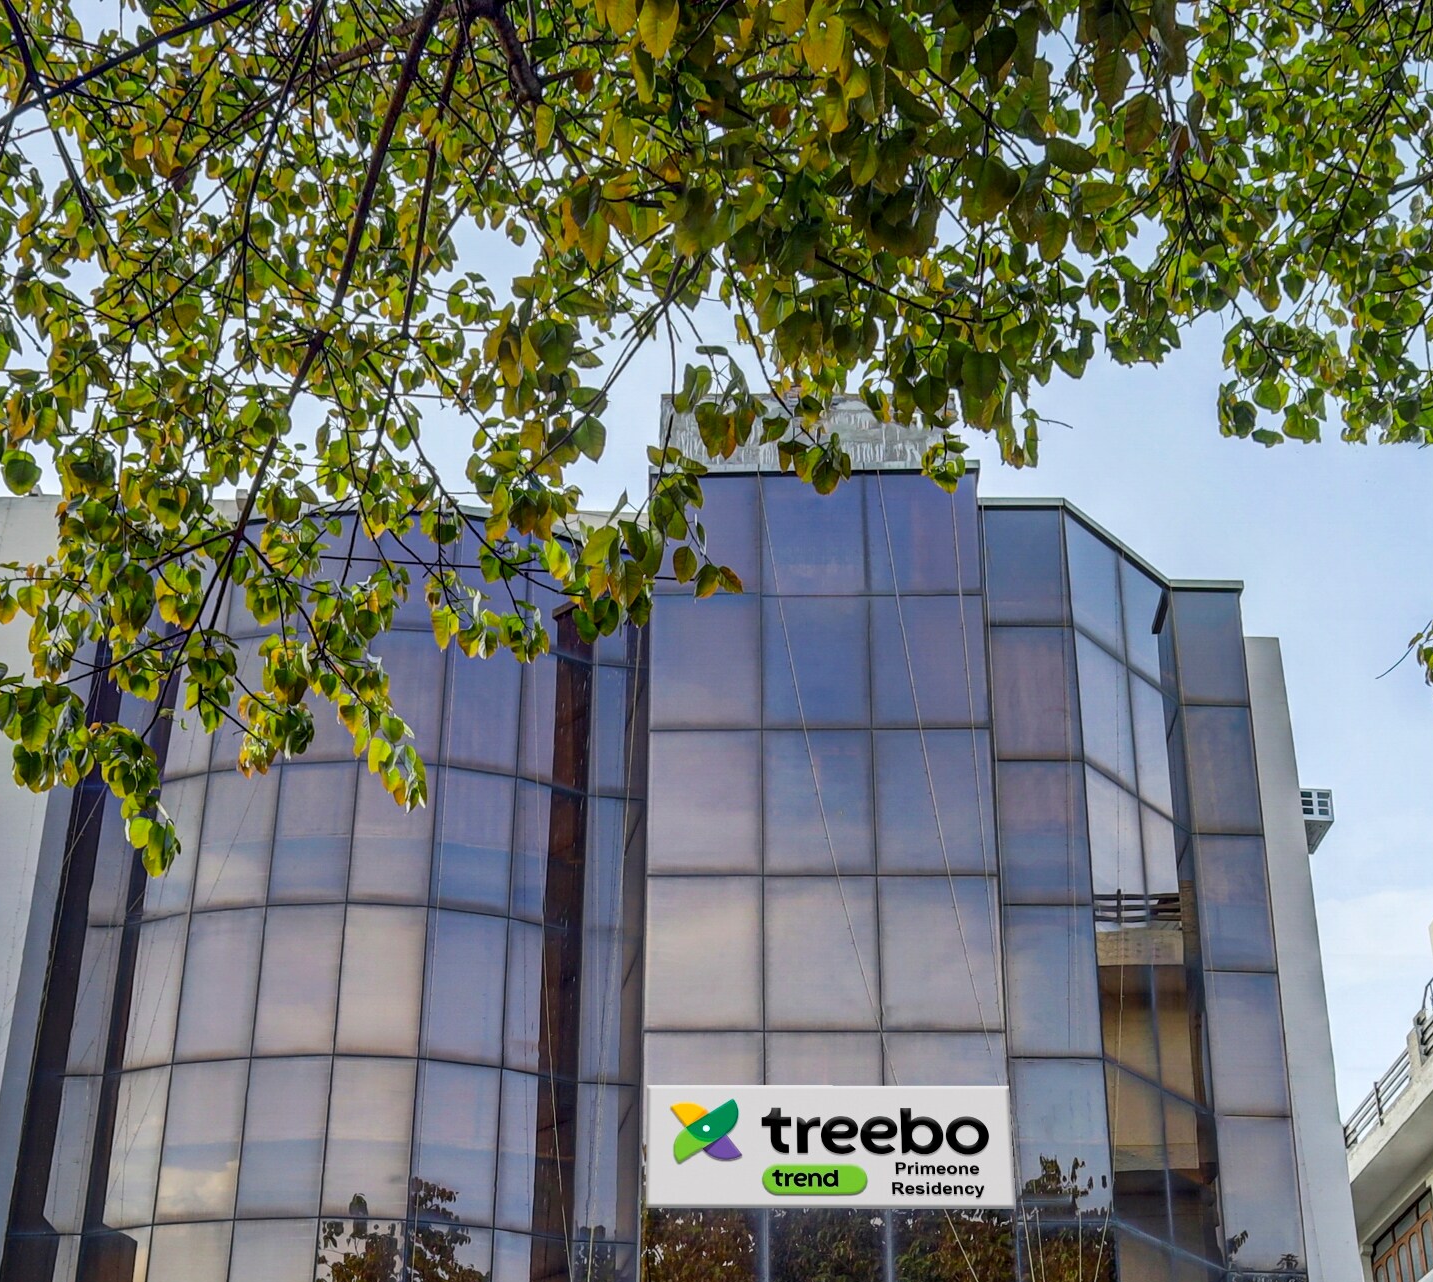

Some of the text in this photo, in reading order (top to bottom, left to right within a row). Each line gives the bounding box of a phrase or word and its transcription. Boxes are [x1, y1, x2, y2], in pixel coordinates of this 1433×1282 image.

[761, 1107, 990, 1155] treebo
[894, 1161, 980, 1176] Primeone
[771, 1168, 839, 1188] trend
[891, 1181, 985, 1198] Residency
